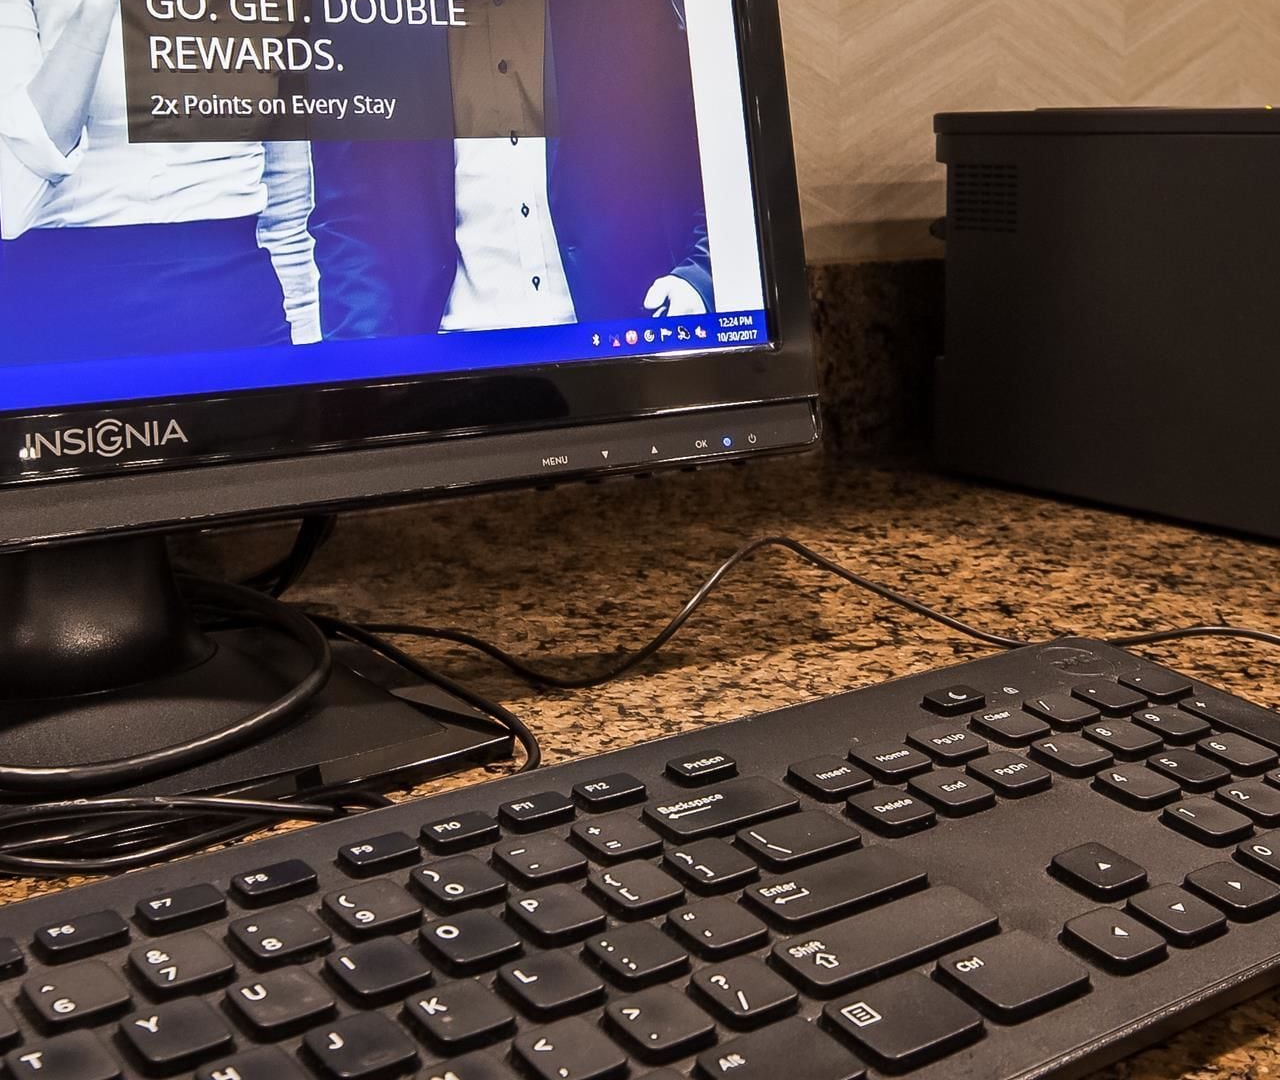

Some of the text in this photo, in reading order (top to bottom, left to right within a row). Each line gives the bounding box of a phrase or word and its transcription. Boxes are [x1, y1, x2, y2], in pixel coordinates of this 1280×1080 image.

[150, 36, 344, 72] REWARDS.
[151, 94, 397, 120] 2x Points on Every Stay
[718, 315, 753, 327] 12:24 PM
[717, 329, 757, 342] 10/30/2017
[22, 419, 188, 458] INSIGNIA
[695, 439, 708, 449] OK
[542, 456, 568, 467] MENU
[984, 710, 1011, 721] Clear
[1145, 713, 1161, 722] 9
[1095, 727, 1112, 737] 8
[1044, 743, 1058, 753] 7
[1211, 742, 1227, 751] 6
[683, 754, 725, 770] PrtScn
[876, 749, 910, 763] Home
[1160, 758, 1177, 768] 5
[815, 767, 852, 781] Insert
[1112, 773, 1127, 784] 4
[584, 782, 610, 793] F12
[942, 781, 967, 793] End
[1230, 789, 1250, 801] 2
[511, 801, 535, 813] F11
[657, 792, 724, 815] Backspace
[873, 797, 913, 813] Delete
[1179, 807, 1196, 818] 1
[433, 821, 461, 834] F10
[350, 844, 374, 856] F9
[245, 873, 269, 885] F8
[759, 881, 798, 898] Enter
[150, 898, 172, 910] F7
[520, 899, 540, 913] P
[354, 910, 375, 924] 9
[48, 924, 75, 938] F6
[260, 938, 283, 951] 8
[788, 940, 826, 959] Shift
[956, 956, 984, 972] Ctrl
[159, 966, 177, 981] 7
[513, 970, 538, 984] L
[240, 984, 267, 1001] U
[53, 999, 76, 1013] 6
[419, 997, 448, 1015] K
[135, 1015, 159, 1033] Y
[327, 1032, 344, 1050] J
[19, 1051, 43, 1069] T
[719, 1053, 746, 1071] Alt
